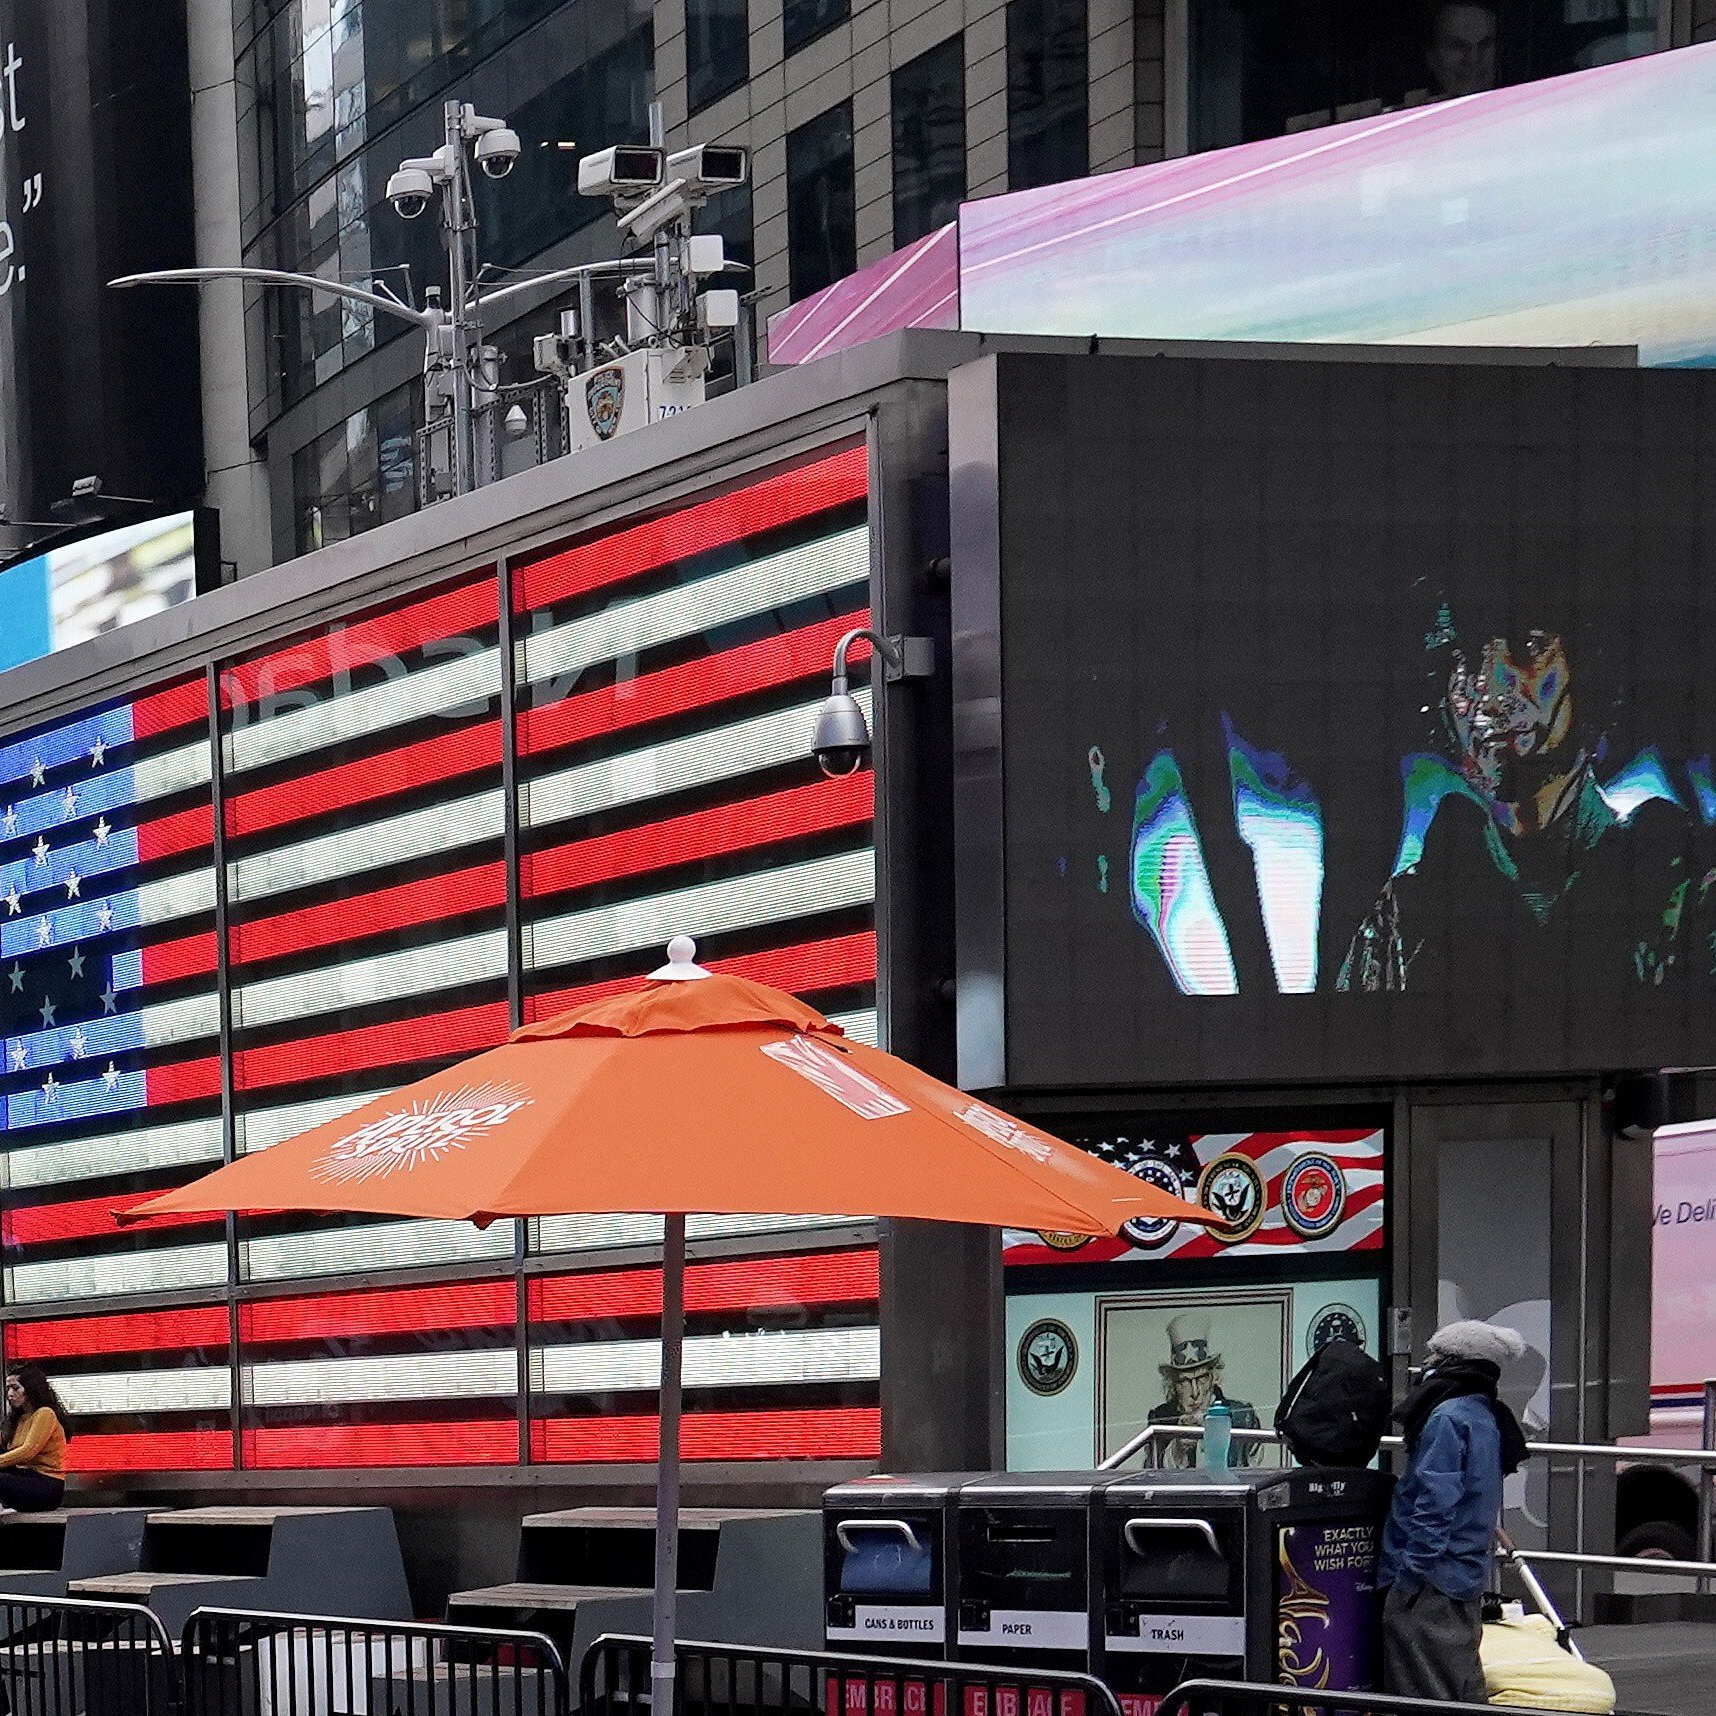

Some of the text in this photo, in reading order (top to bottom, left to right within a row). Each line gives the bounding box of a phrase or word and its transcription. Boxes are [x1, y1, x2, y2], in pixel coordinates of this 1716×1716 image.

[1323, 1526, 1374, 1541] EXACTLY
[1314, 1542, 1348, 1556] WHAT
[1314, 1558, 1344, 1572] WISH
[865, 1618, 935, 1631] CANS & BOTTLES
[1002, 1623, 1033, 1636] PAPER
[1150, 1628, 1185, 1641] TRASH
